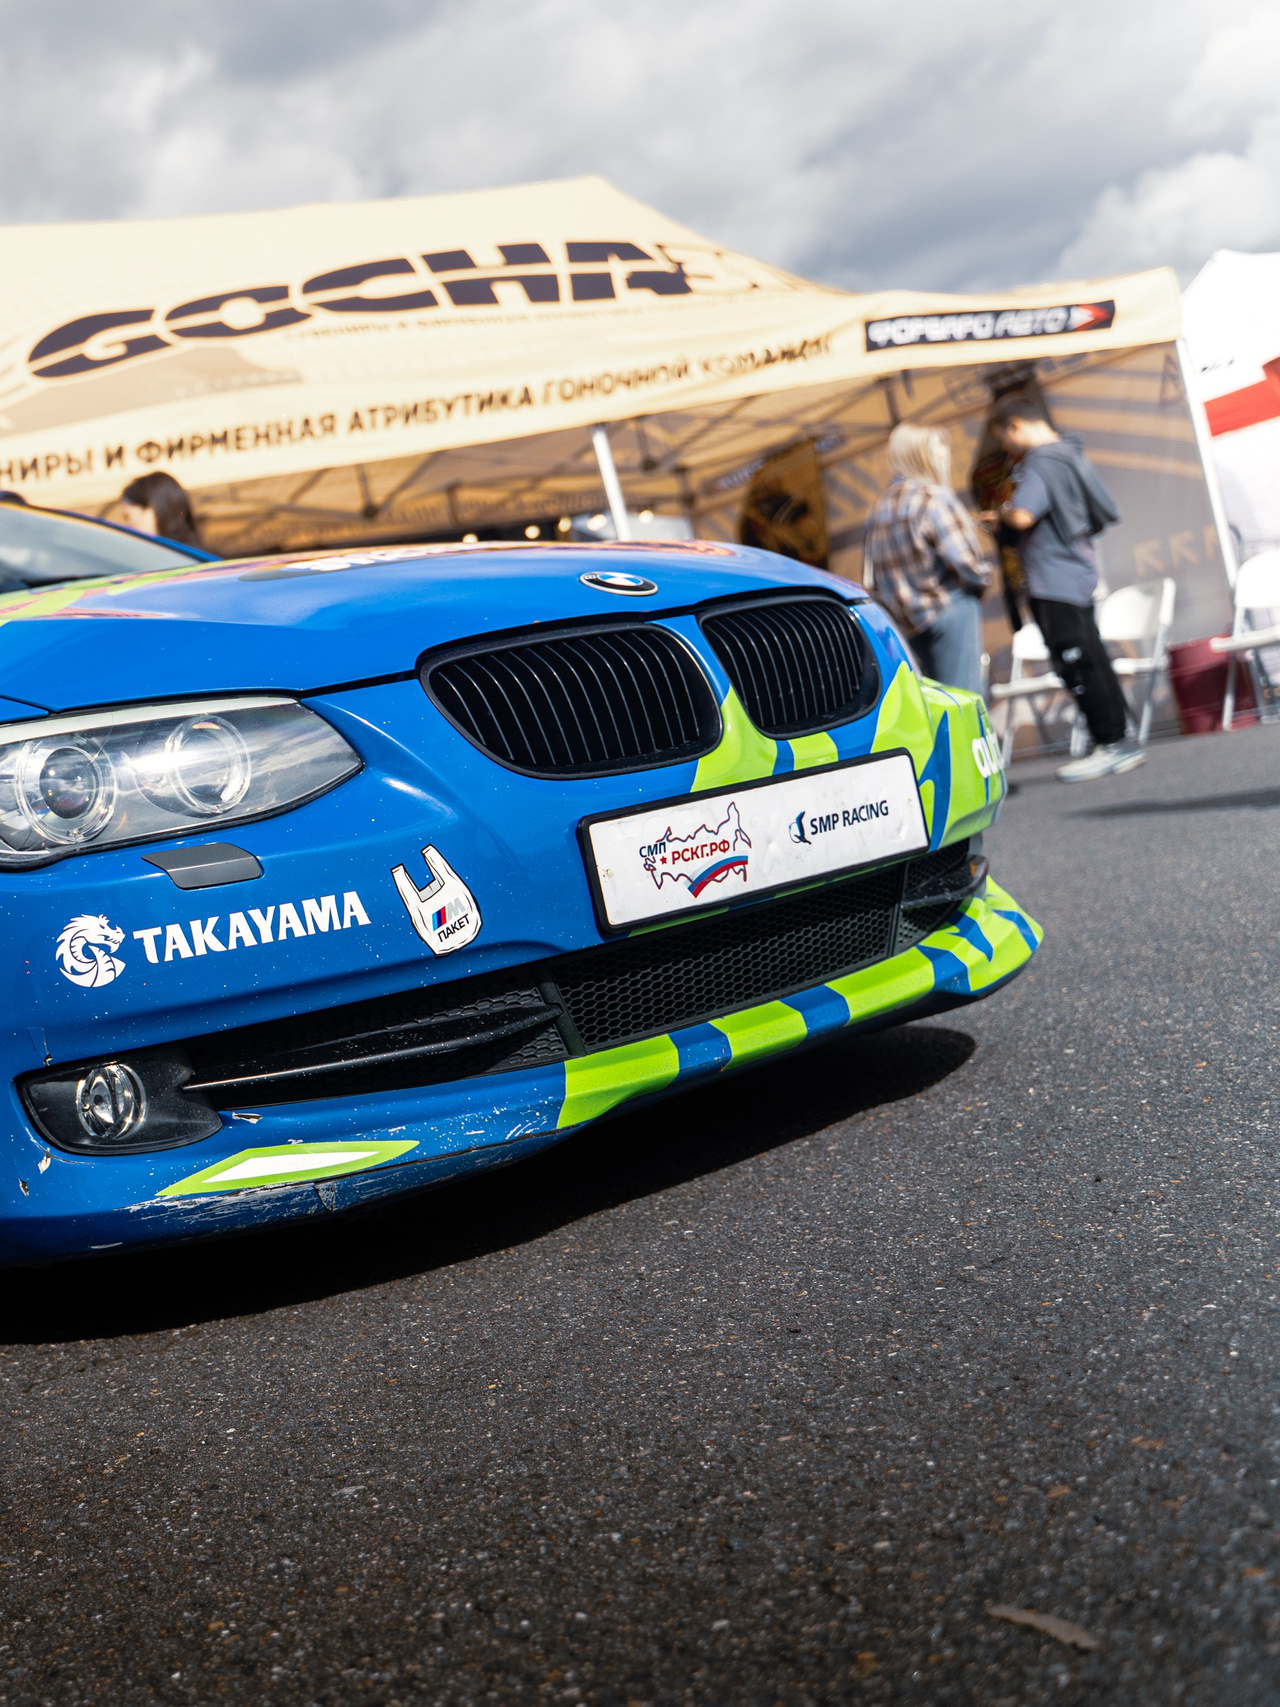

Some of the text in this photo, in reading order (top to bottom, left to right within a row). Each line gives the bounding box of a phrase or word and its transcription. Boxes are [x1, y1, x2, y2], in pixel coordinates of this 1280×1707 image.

[105, 444, 127, 470] И
[136, 412, 337, 464] ФИРМЕННАЯ
[348, 386, 535, 435] АТРИБУТИКА
[543, 354, 690, 403] ГОНОЧНОЙ
[810, 799, 889, 836] SMP RACING
[638, 841, 667, 858] СМП
[671, 838, 731, 865] РСКГ.РФ
[132, 890, 372, 964] TAKAYAMA
[437, 912, 470, 943] ПАКЕТ
